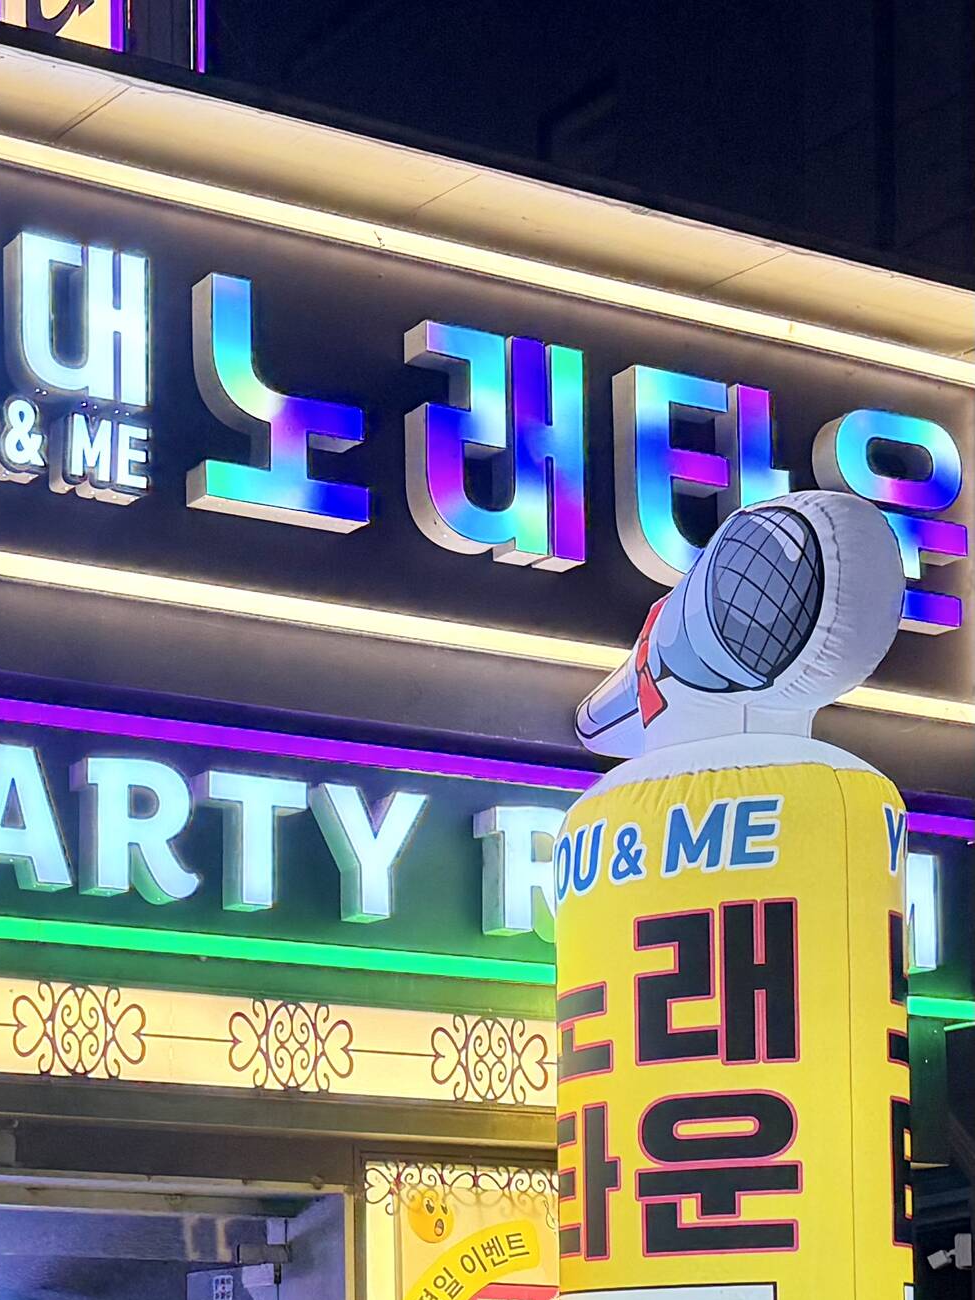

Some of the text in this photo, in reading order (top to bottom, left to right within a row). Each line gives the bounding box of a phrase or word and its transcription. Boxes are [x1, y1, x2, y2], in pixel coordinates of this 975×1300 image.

[57, 413, 149, 498] ME
[190, 272, 968, 637] 노래타운
[555, 799, 780, 897] OU & ME
[460, 1232, 530, 1273] 이벤트
